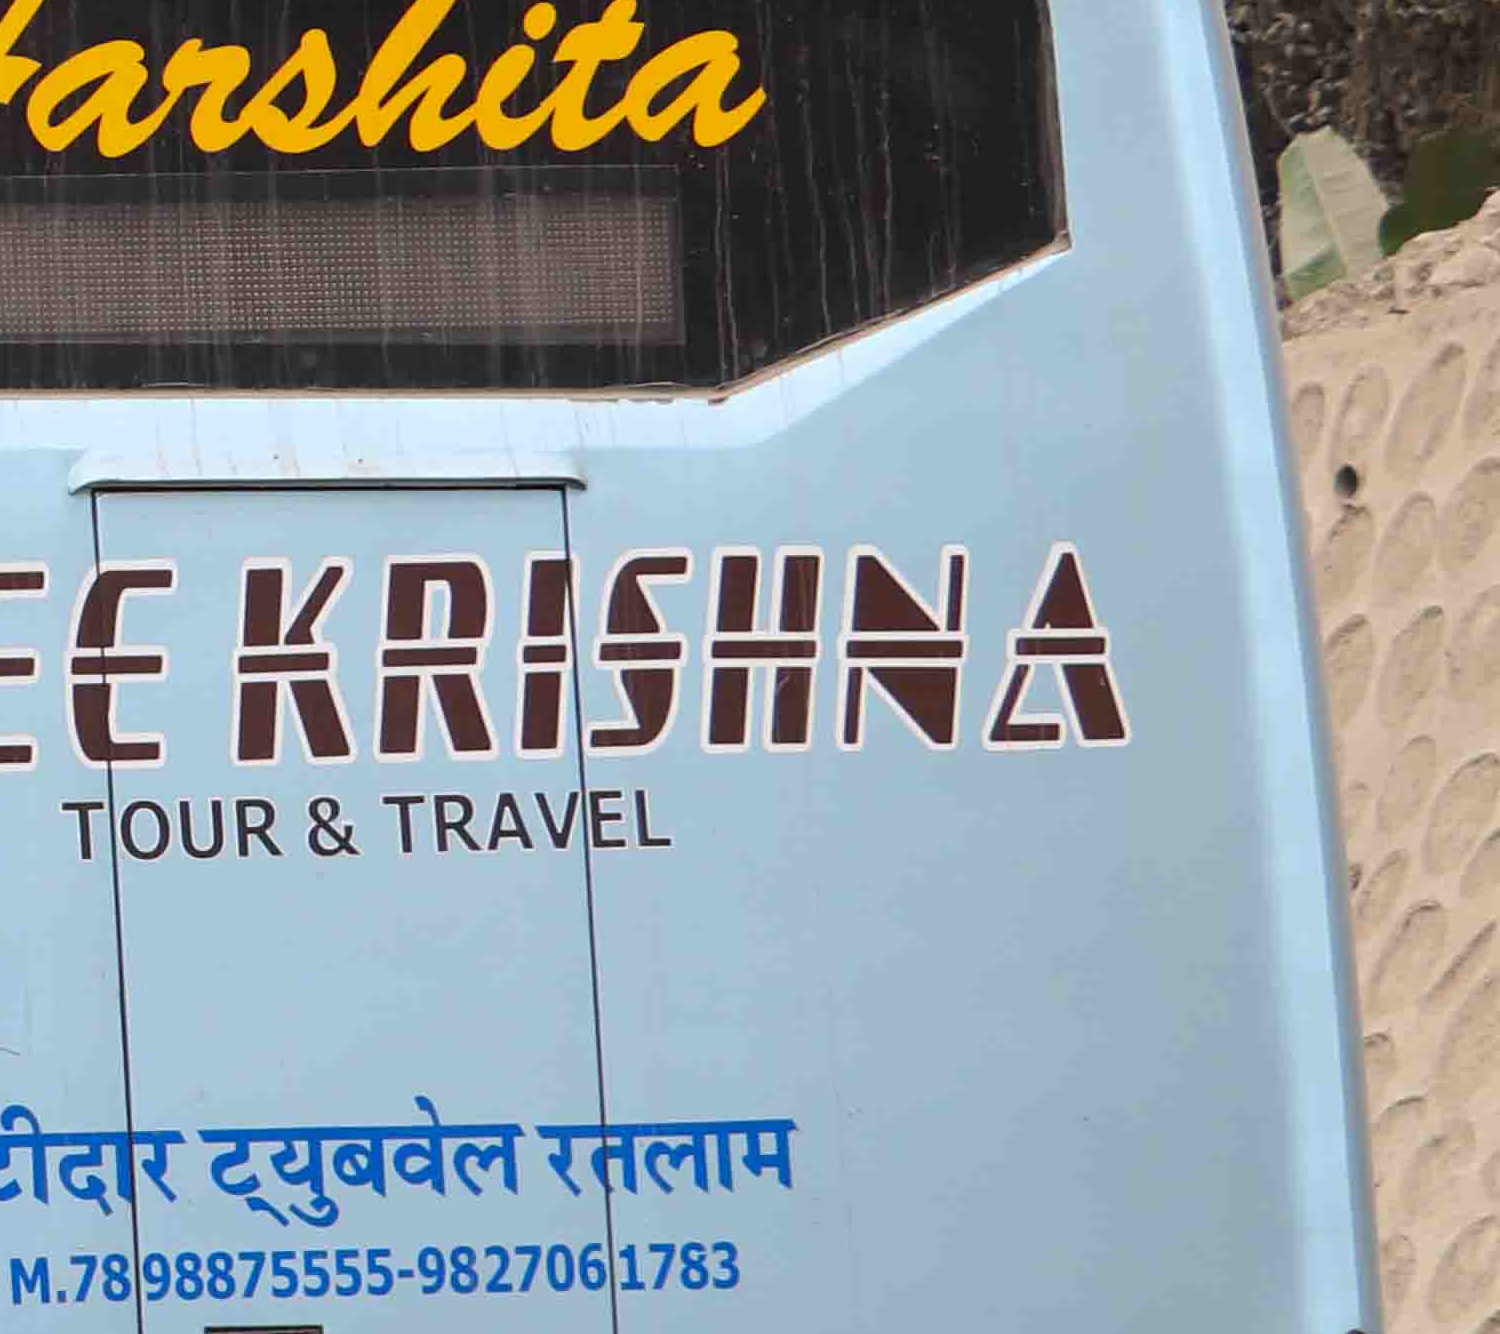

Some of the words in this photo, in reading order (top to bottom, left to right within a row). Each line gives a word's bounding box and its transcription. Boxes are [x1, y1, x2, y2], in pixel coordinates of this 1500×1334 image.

[230, 542, 1132, 765] KRISHNA
[61, 798, 282, 862] TOUR
[306, 795, 360, 857] &
[383, 788, 673, 854] TRAVEL
[536, 1118, 798, 1197] रतलाम
